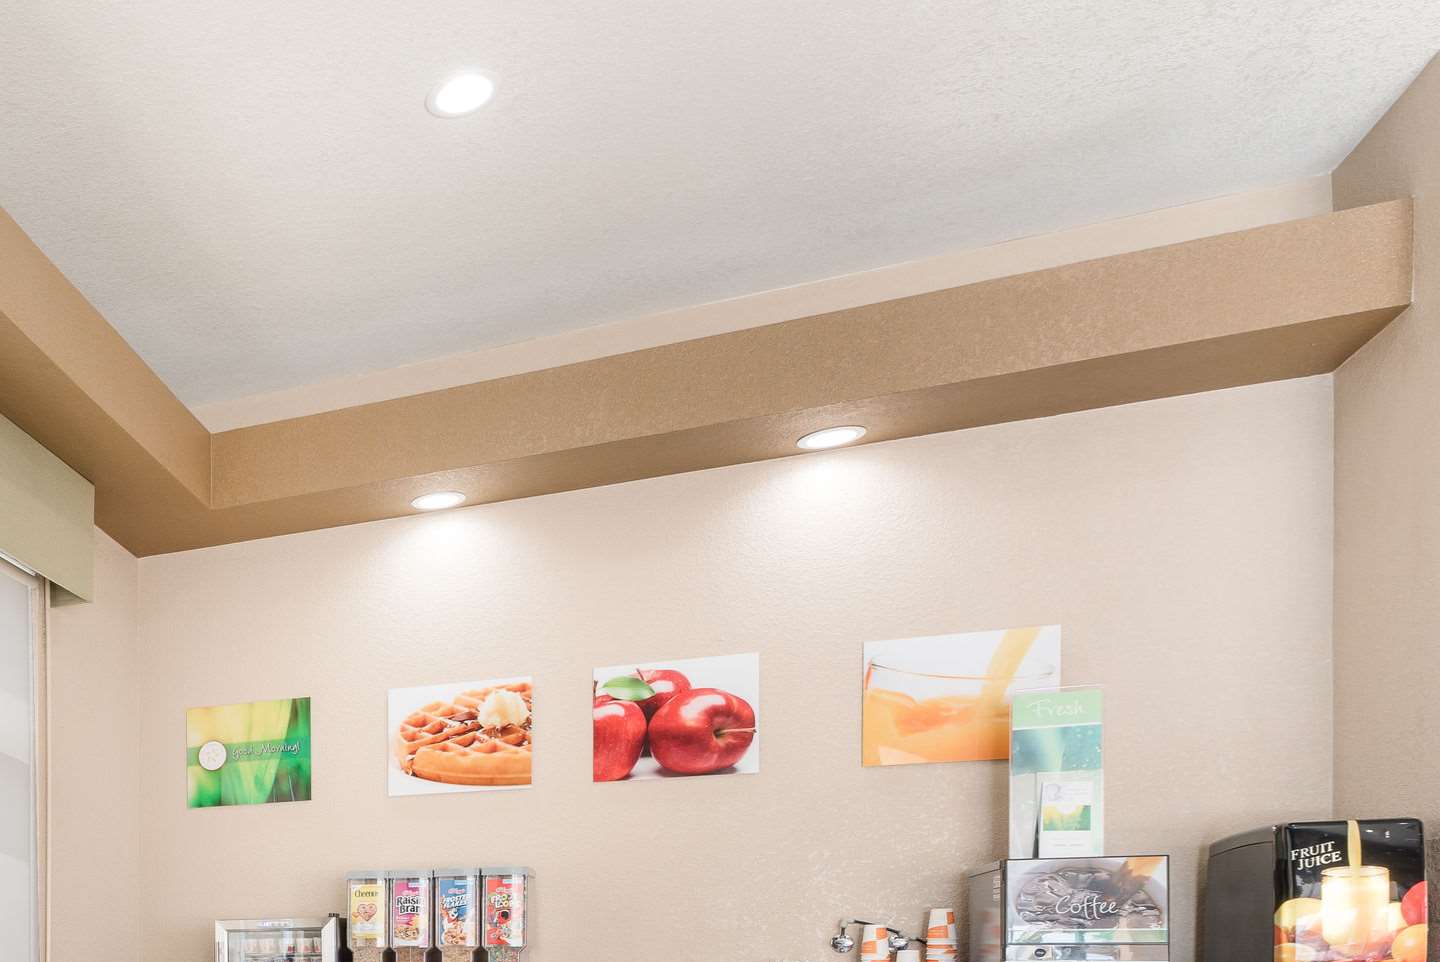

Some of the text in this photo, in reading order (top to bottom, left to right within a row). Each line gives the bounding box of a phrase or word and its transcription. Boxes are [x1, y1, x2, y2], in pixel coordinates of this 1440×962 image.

[1290, 841, 1336, 862] FRUIT
[1297, 851, 1342, 871] JUICE
[1055, 896, 1118, 920] Coffee
